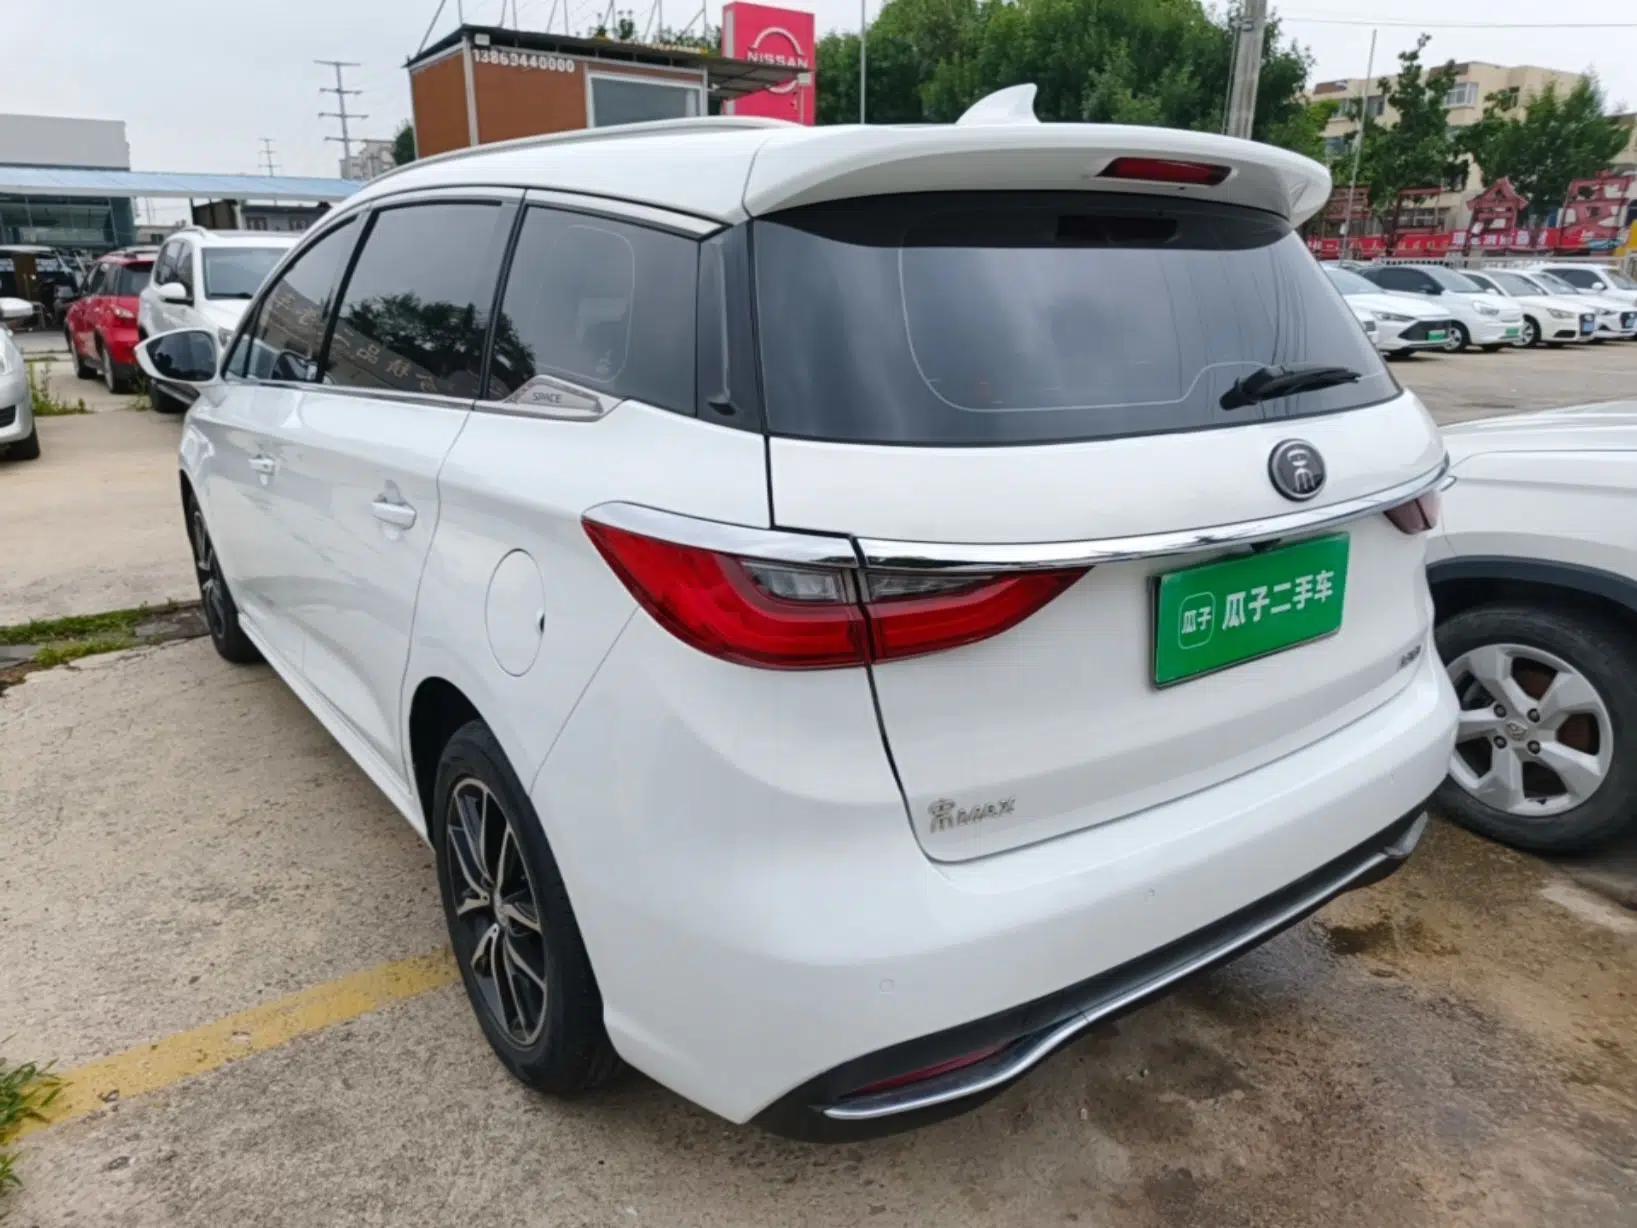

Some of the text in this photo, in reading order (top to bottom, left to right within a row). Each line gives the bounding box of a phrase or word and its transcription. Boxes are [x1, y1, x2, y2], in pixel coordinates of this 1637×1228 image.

[747, 51, 809, 69] NISSAN
[1221, 569, 1335, 631] 瓜子二手车
[1180, 605, 1213, 635] 瓜子
